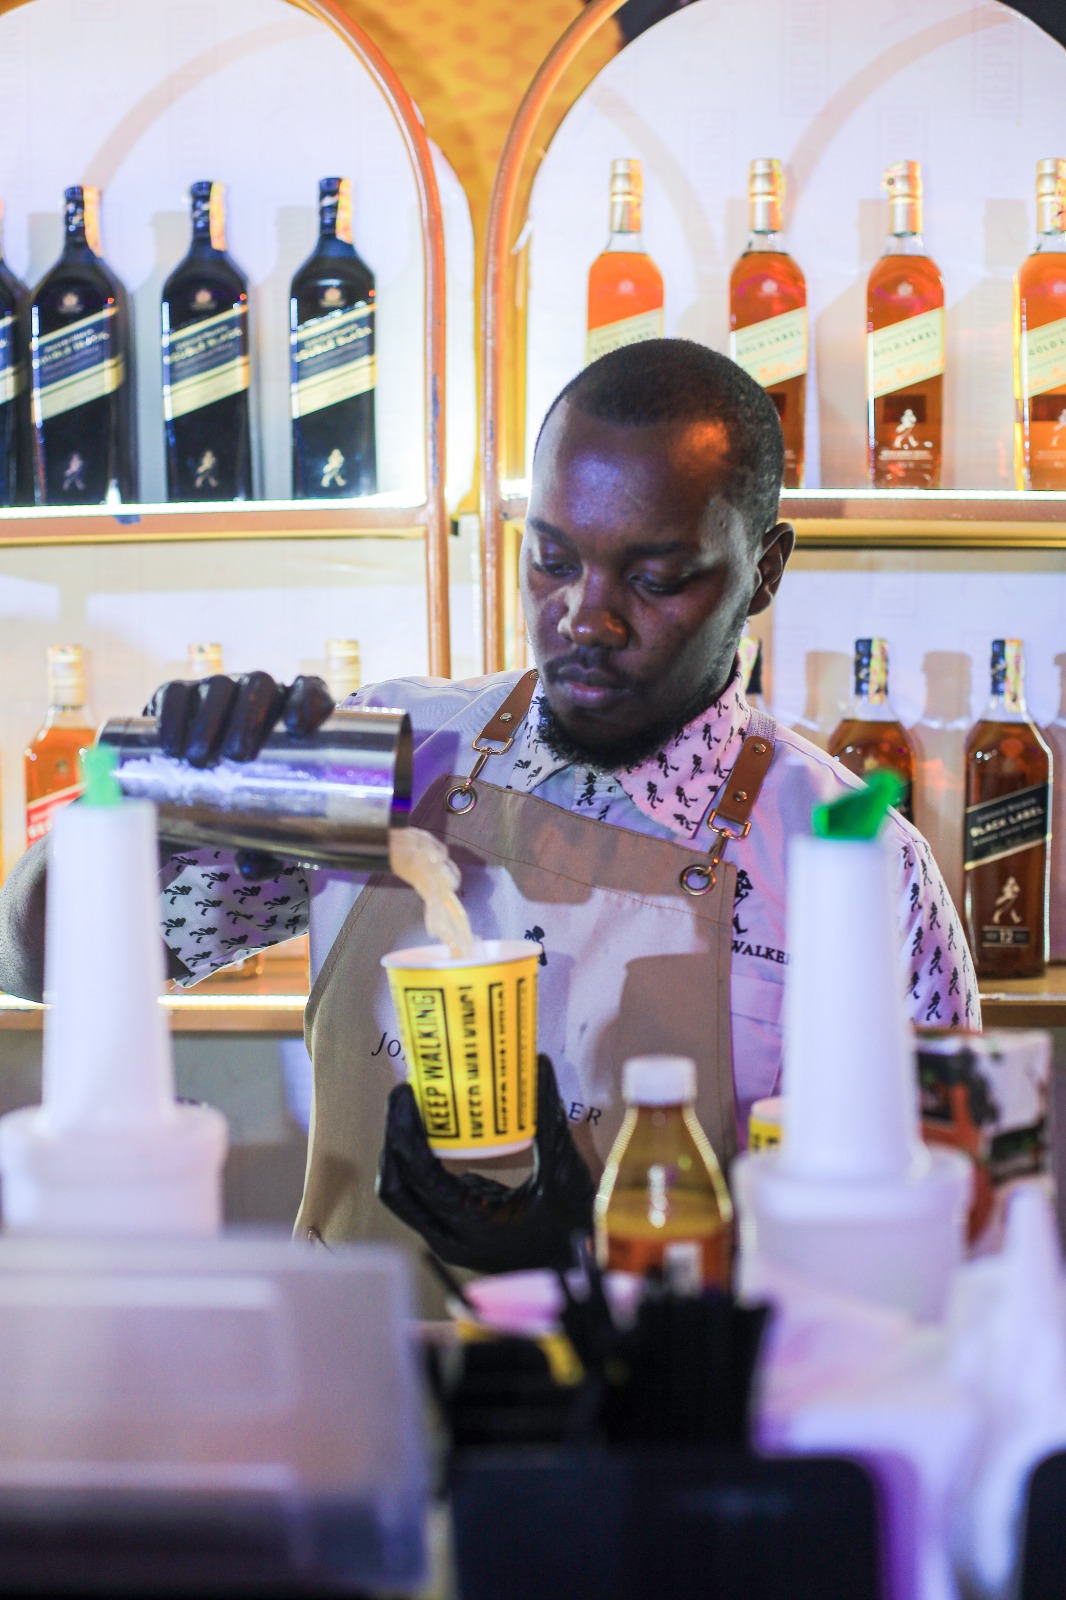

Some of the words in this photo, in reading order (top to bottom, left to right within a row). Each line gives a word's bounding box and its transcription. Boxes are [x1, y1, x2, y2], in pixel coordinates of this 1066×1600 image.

[766, 329, 803, 347] LABEL
[904, 329, 939, 347] LABEL
[1028, 339, 1057, 356] GOLD
[970, 818, 1007, 838] BLACK
[1008, 805, 1045, 825] LABEL
[412, 994, 444, 1081] WALKING
[425, 1086, 452, 1131] KEEP
[569, 1101, 602, 1126] ER
